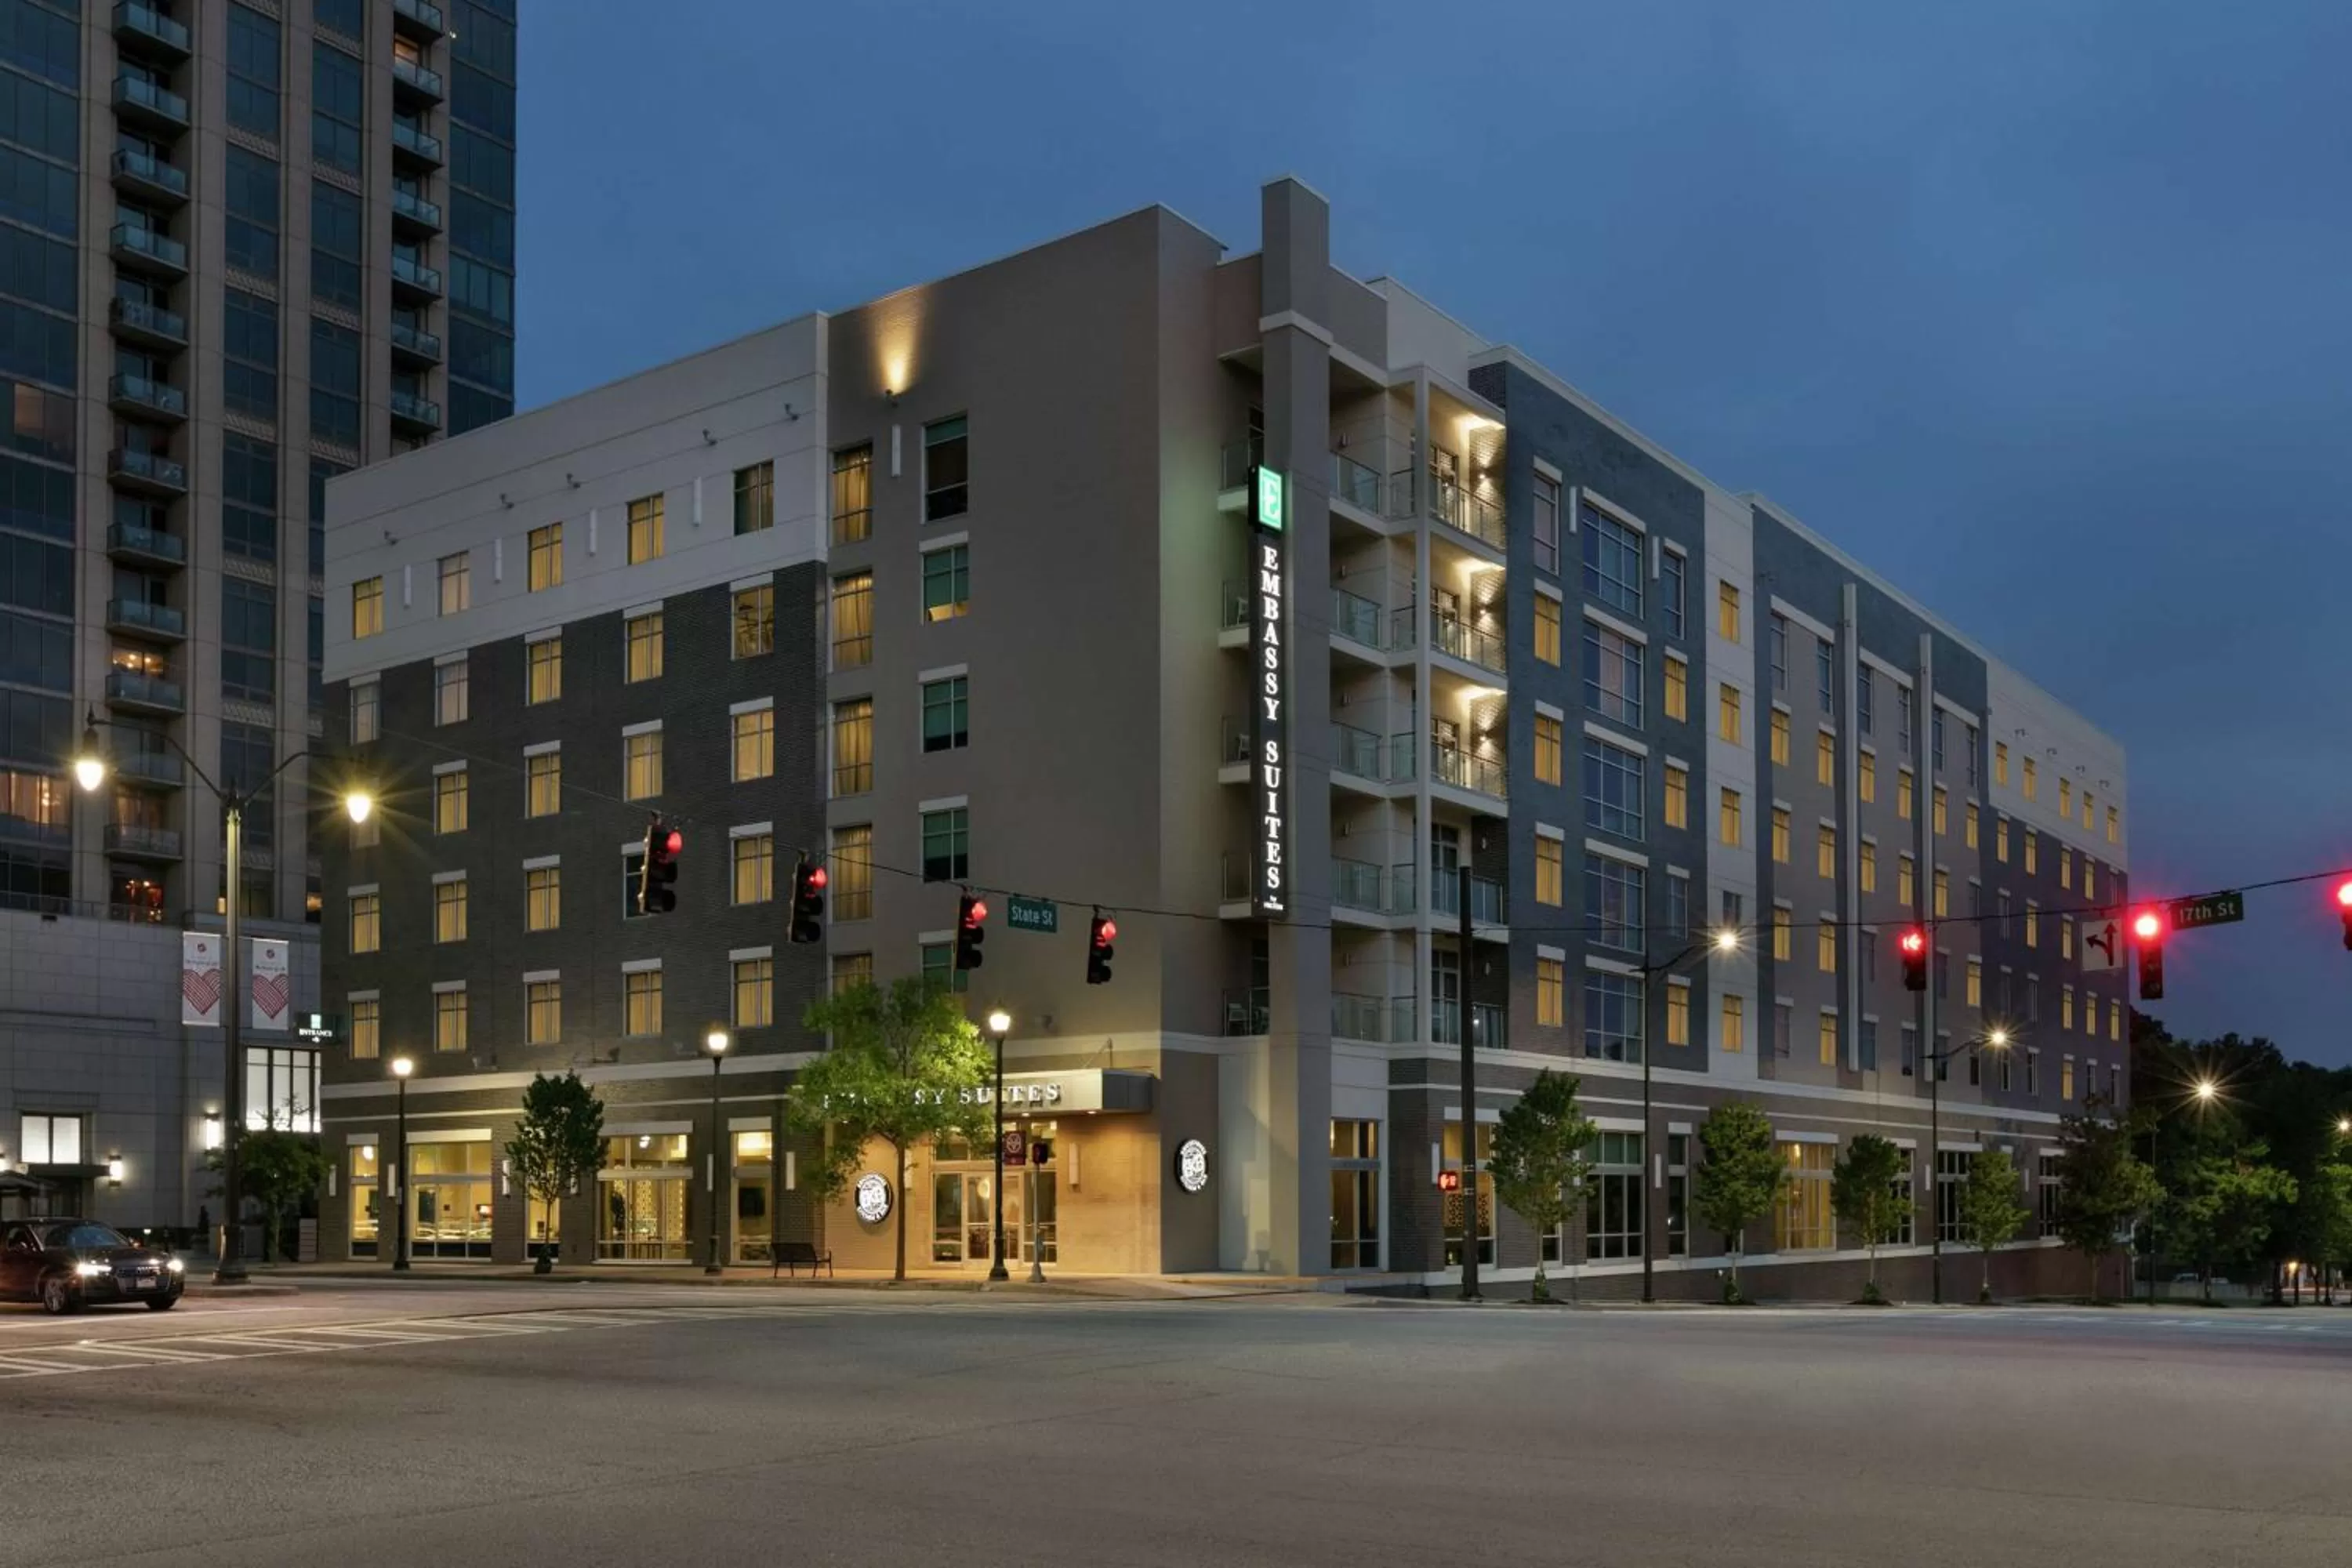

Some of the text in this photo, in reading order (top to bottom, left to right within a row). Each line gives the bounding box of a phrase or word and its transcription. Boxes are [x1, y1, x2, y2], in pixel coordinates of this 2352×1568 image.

[1261, 545, 1280, 721] EMBASSY
[1263, 739, 1282, 889] SUITES
[1011, 905, 1054, 925] State St
[2180, 902, 2236, 924] 17th St
